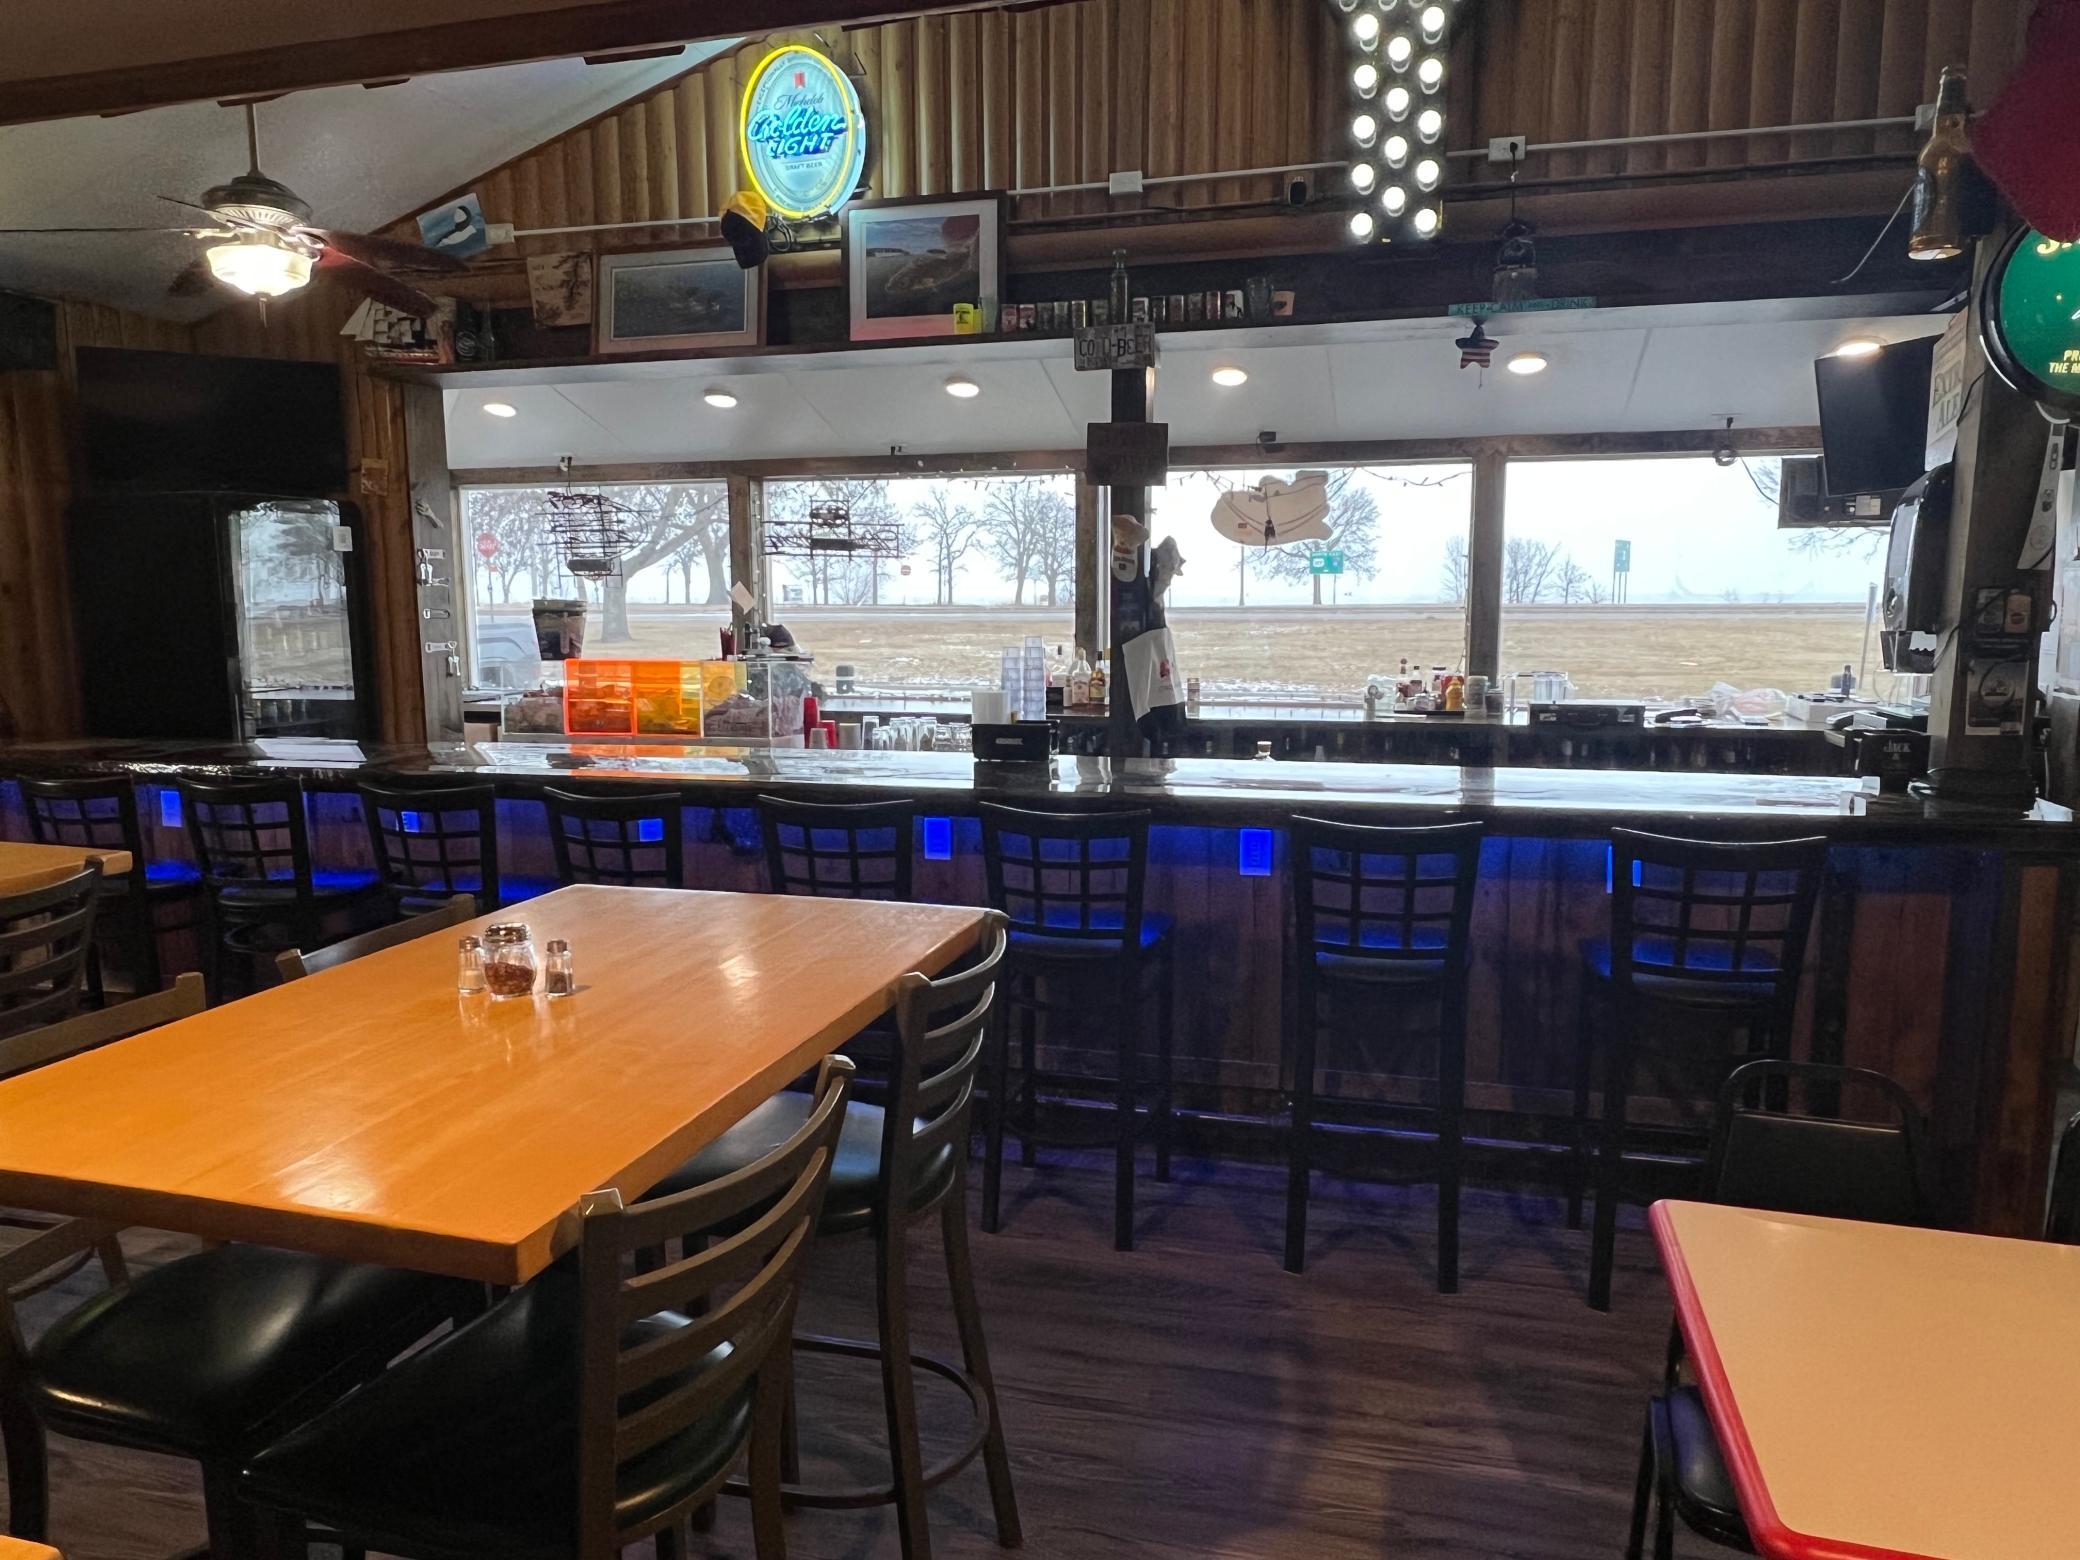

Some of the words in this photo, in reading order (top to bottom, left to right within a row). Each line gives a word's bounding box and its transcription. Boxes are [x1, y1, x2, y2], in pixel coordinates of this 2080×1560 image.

[774, 93, 824, 111] Michelob
[748, 105, 846, 141] Golden
[2049, 362, 2070, 373] THE
